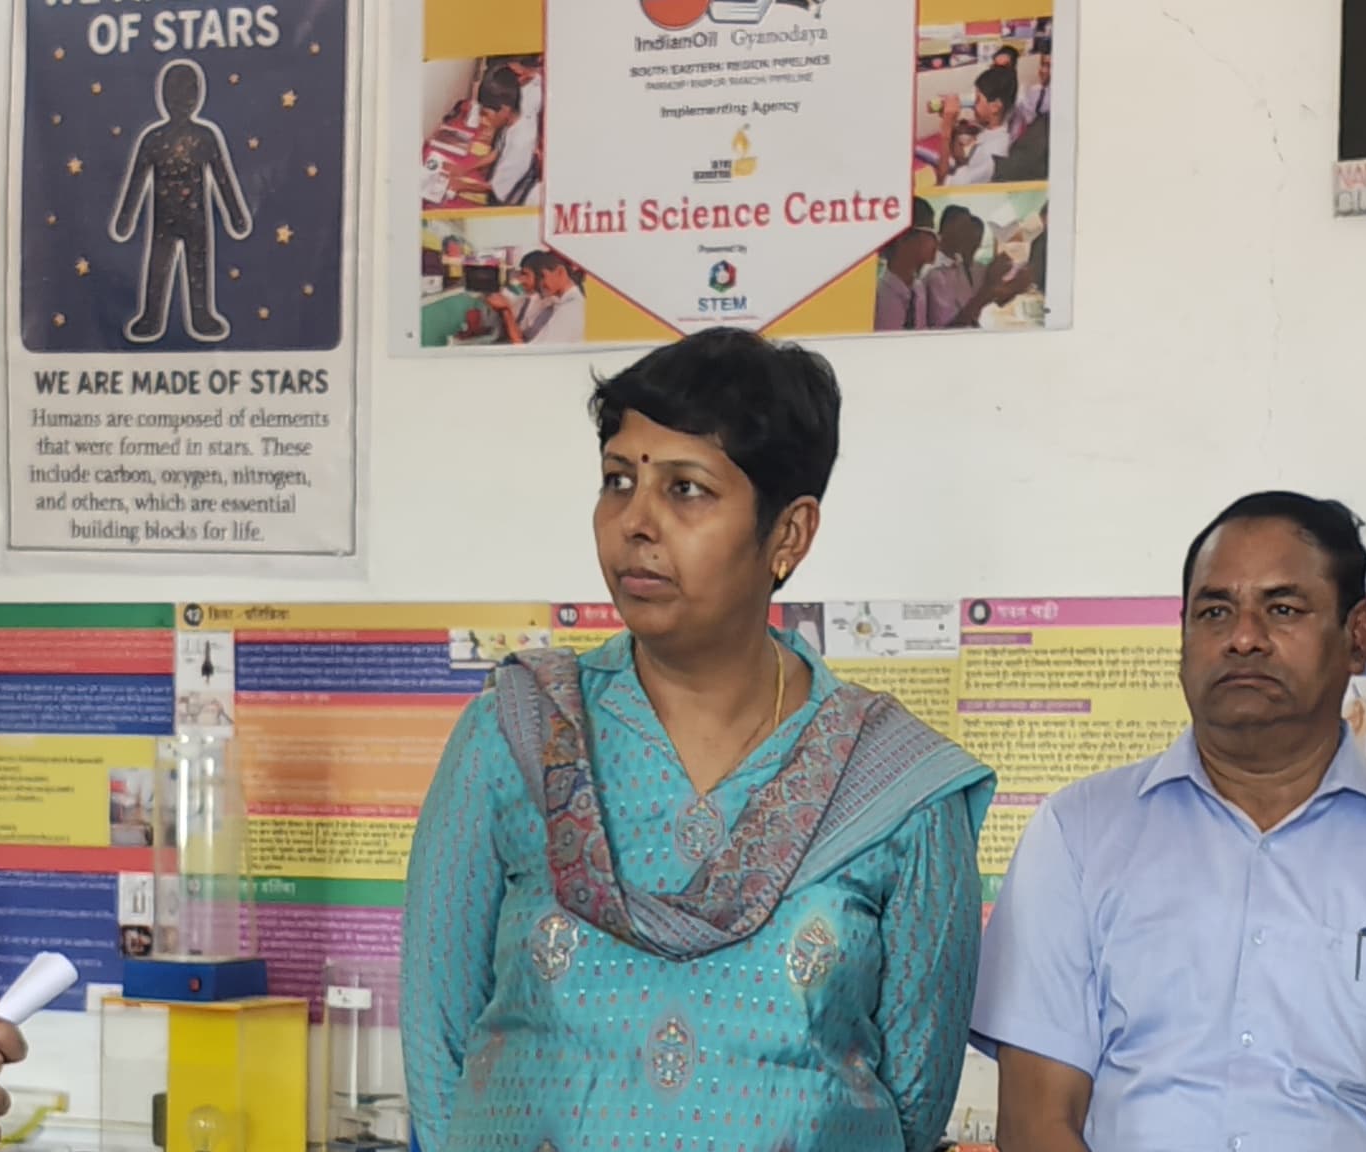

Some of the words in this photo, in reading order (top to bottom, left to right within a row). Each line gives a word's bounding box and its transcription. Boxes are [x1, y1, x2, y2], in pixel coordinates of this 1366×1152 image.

[88, 13, 141, 55] OF
[153, 5, 280, 51] STARS
[635, 31, 718, 51] IndianOil
[660, 103, 747, 119] Implementing
[752, 100, 801, 115] Agency
[553, 200, 627, 235] Mini
[639, 196, 770, 231] Science
[784, 190, 900, 226] Centre
[698, 296, 747, 312] STEM
[35, 370, 70, 395] WE
[76, 370, 123, 395] ARE
[132, 370, 200, 395] MADE
[208, 370, 241, 395] OF
[250, 369, 329, 395] STARS
[32, 408, 101, 427] Humans
[106, 412, 134, 427] are
[137, 408, 222, 432] composed
[229, 408, 249, 427] of
[250, 409, 330, 428] elements
[36, 437, 70, 456] that
[75, 442, 112, 456] were
[118, 437, 181, 456] formed
[186, 438, 203, 456] in
[207, 440, 253, 457] stars.
[261, 436, 312, 456] These
[29, 464, 89, 483] include
[94, 464, 156, 485] carbon,
[161, 469, 228, 489] oxygen,
[232, 465, 312, 489] nitrogen,
[36, 493, 66, 511] and
[71, 492, 129, 513] others,
[134, 492, 184, 512] which
[191, 497, 217, 512] are
[221, 494, 296, 513] essential
[70, 520, 140, 544] building
[144, 520, 197, 540] blocks
[203, 520, 228, 540] for
[232, 520, 265, 541] life.
